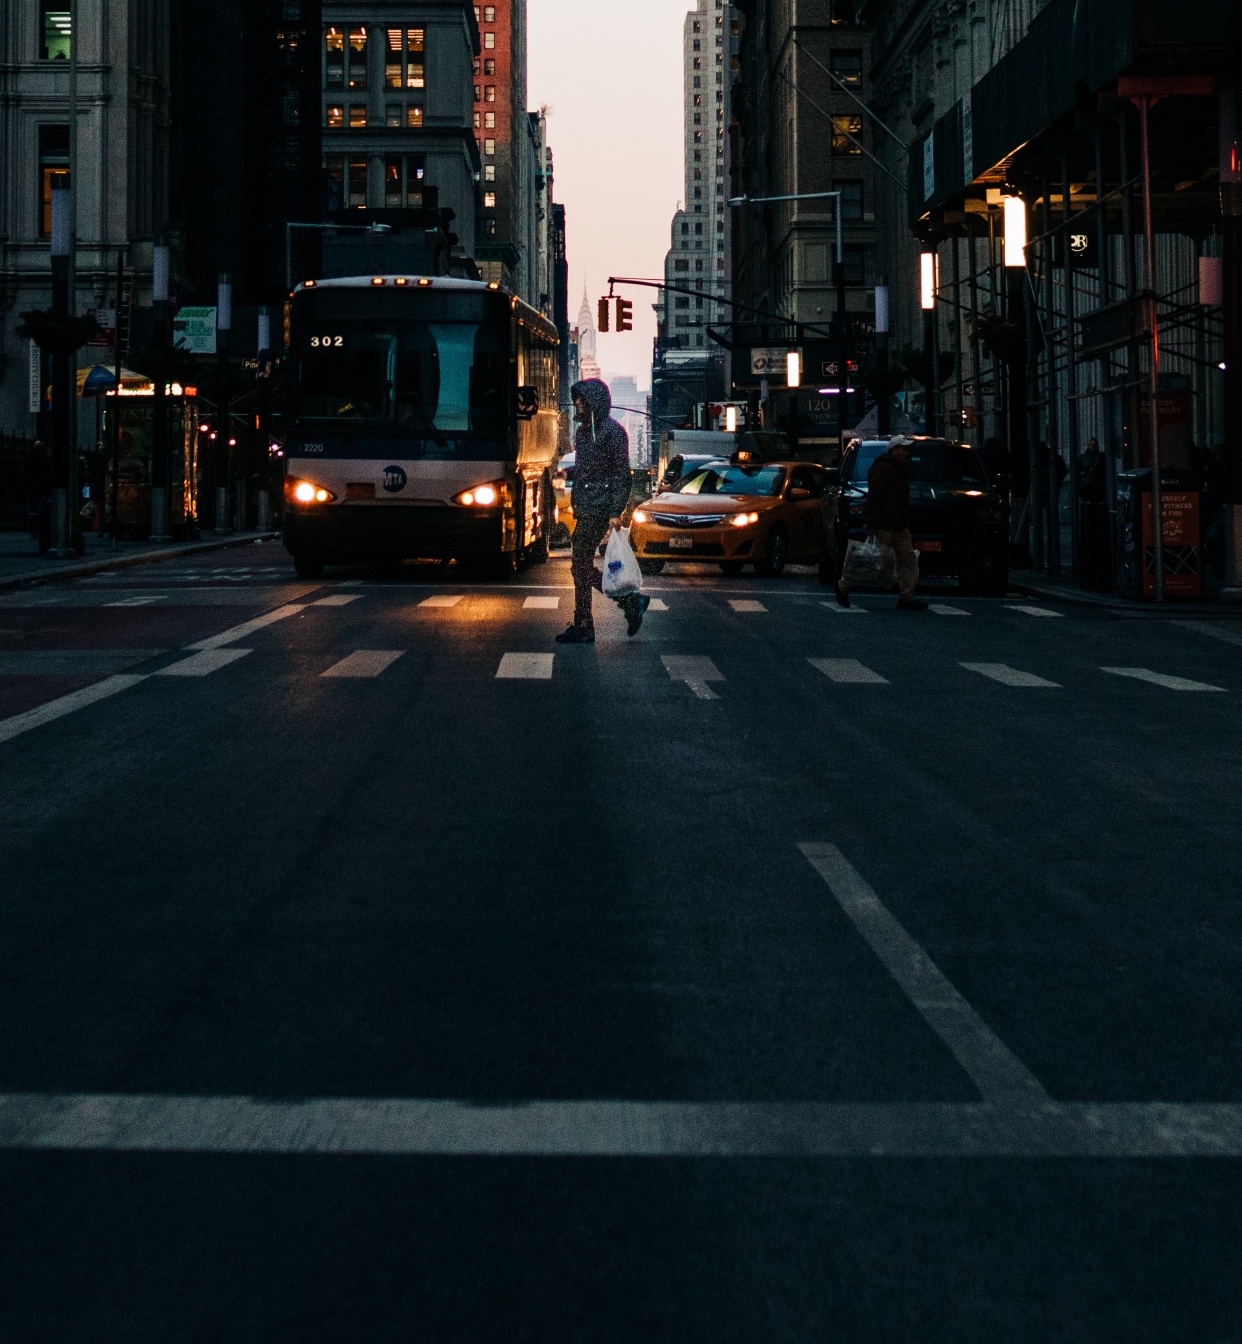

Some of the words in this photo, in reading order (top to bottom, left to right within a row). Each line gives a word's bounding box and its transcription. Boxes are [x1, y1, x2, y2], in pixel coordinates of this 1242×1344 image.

[310, 336, 344, 347] 302
[808, 399, 831, 411] 120
[304, 443, 324, 452] 2220
[384, 471, 403, 487] MTA
